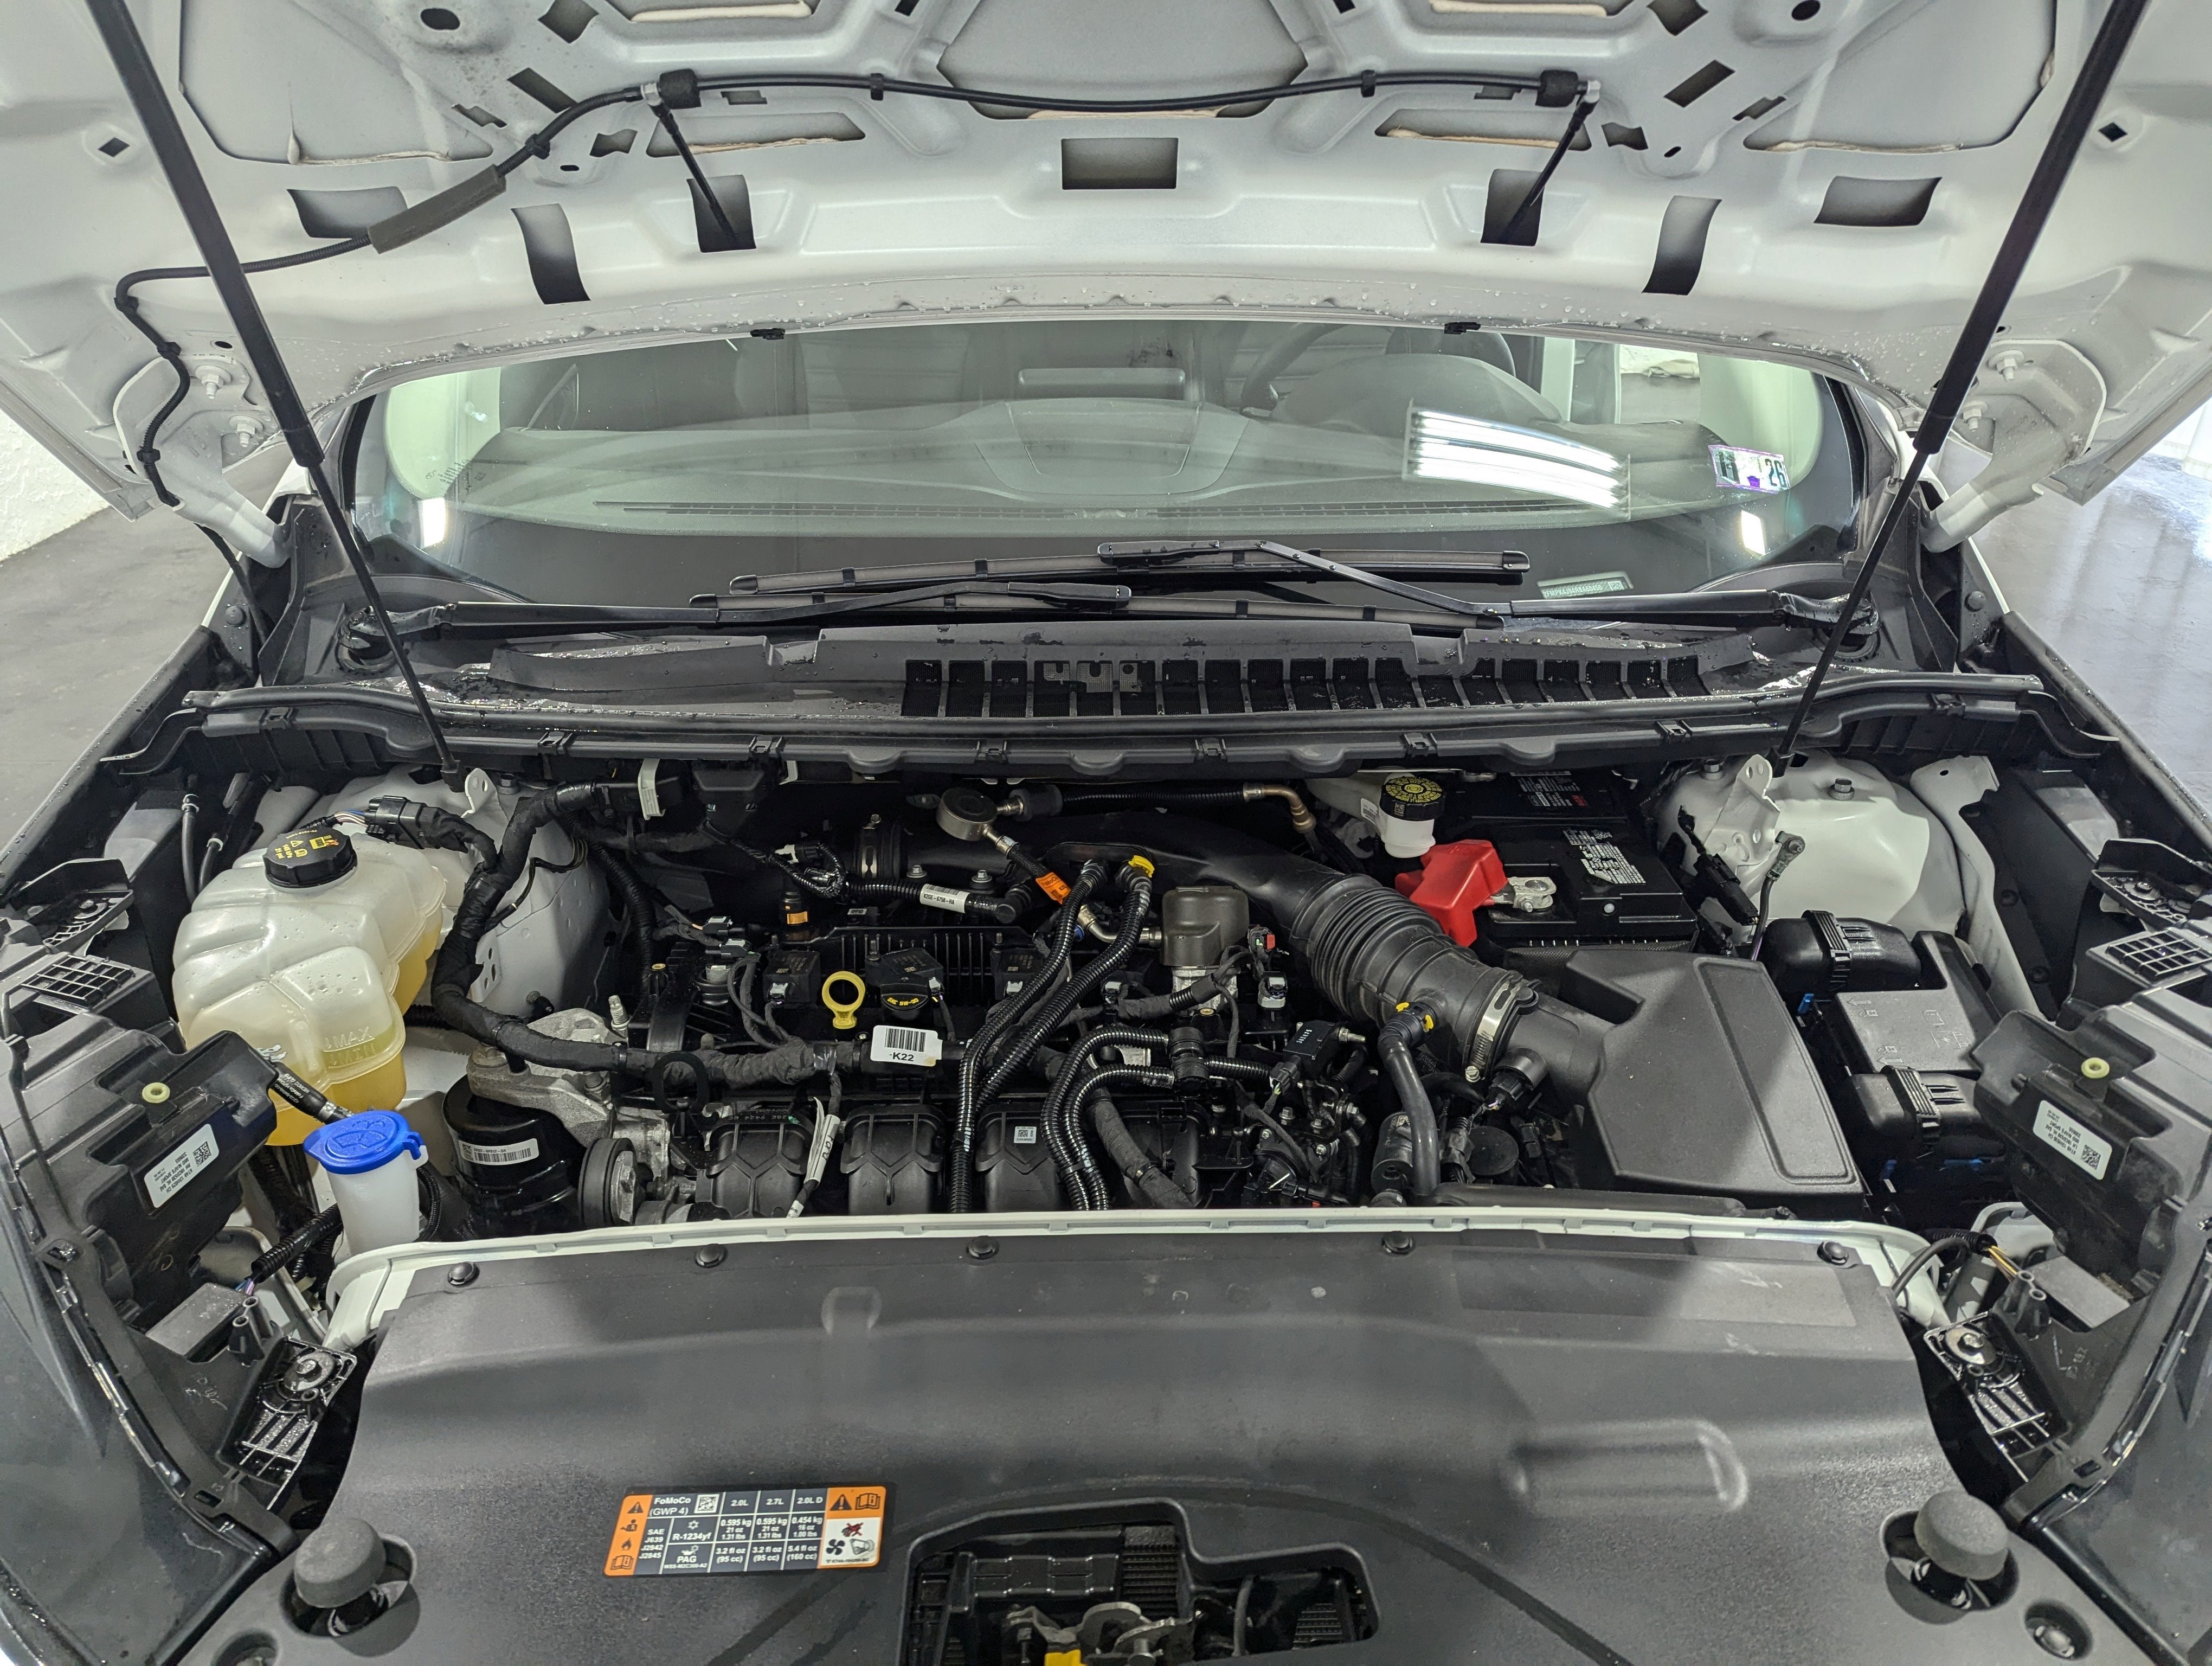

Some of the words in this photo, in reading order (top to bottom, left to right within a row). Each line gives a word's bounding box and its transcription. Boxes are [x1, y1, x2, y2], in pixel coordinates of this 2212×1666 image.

[1765, 458, 1787, 488] 26
[899, 998, 919, 1006] 5W-30
[333, 1026, 372, 1048] MAX
[892, 1052, 914, 1061] K22
[650, 1508, 677, 1516] (GWP
[678, 1507, 689, 1515] 4)
[742, 1518, 751, 1527] kg
[777, 1517, 787, 1526] kg
[813, 1516, 822, 1524] kg
[672, 1532, 712, 1541] R-1234yf
[753, 1555, 766, 1563] (95
